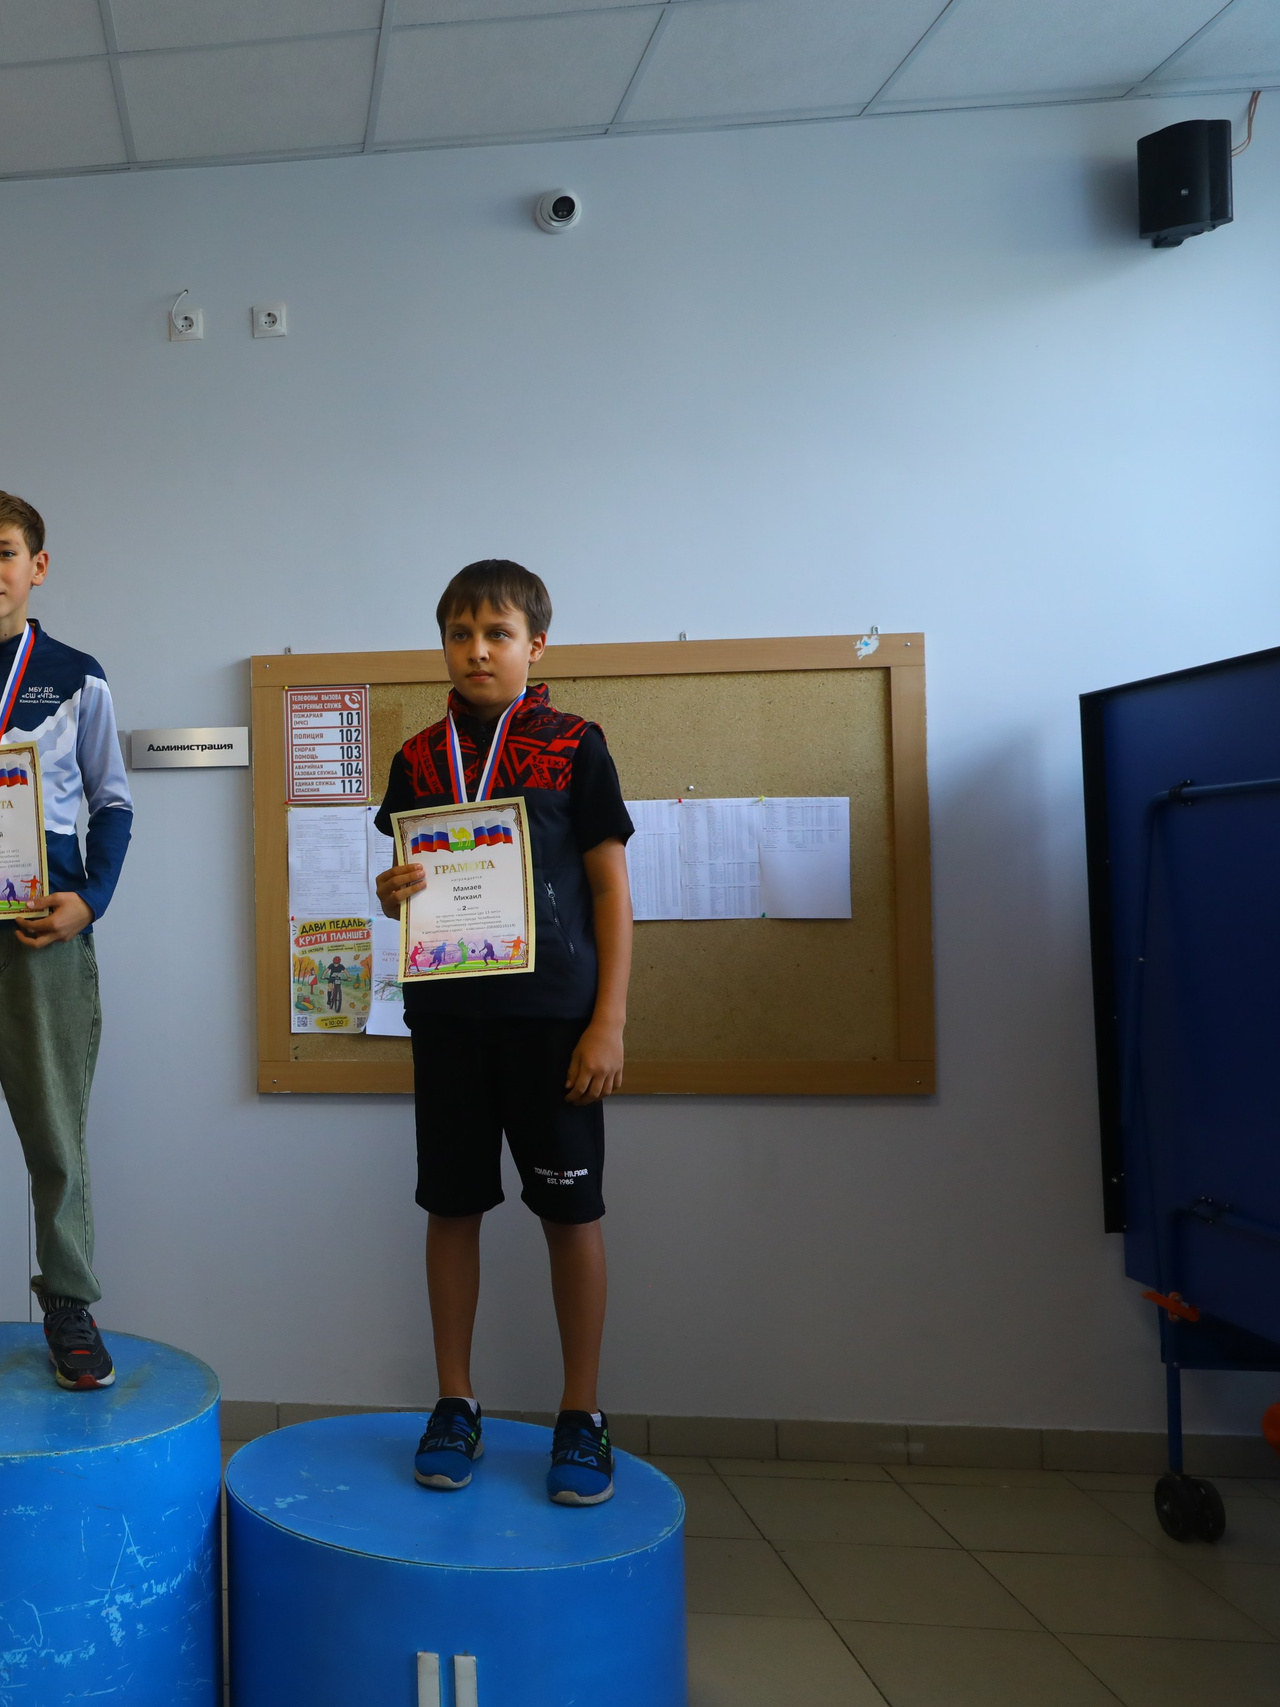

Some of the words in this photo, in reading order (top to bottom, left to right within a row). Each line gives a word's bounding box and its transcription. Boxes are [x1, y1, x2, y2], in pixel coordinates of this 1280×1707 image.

[339, 712, 361, 726] 101
[339, 729, 361, 742] 102
[147, 743, 233, 752] Администрация
[340, 745, 361, 759] 103
[340, 762, 362, 776] 104
[341, 779, 362, 793] 112
[434, 860, 495, 874] ГРАМОТА
[301, 923, 326, 935] ДАВИ
[330, 919, 366, 930] ПЕДАЛЬ,
[299, 934, 327, 946] КРУТИ
[330, 930, 368, 941] ПЛАНШЕТ
[424, 1437, 467, 1453] FILA
[554, 1449, 598, 1467] FILA
